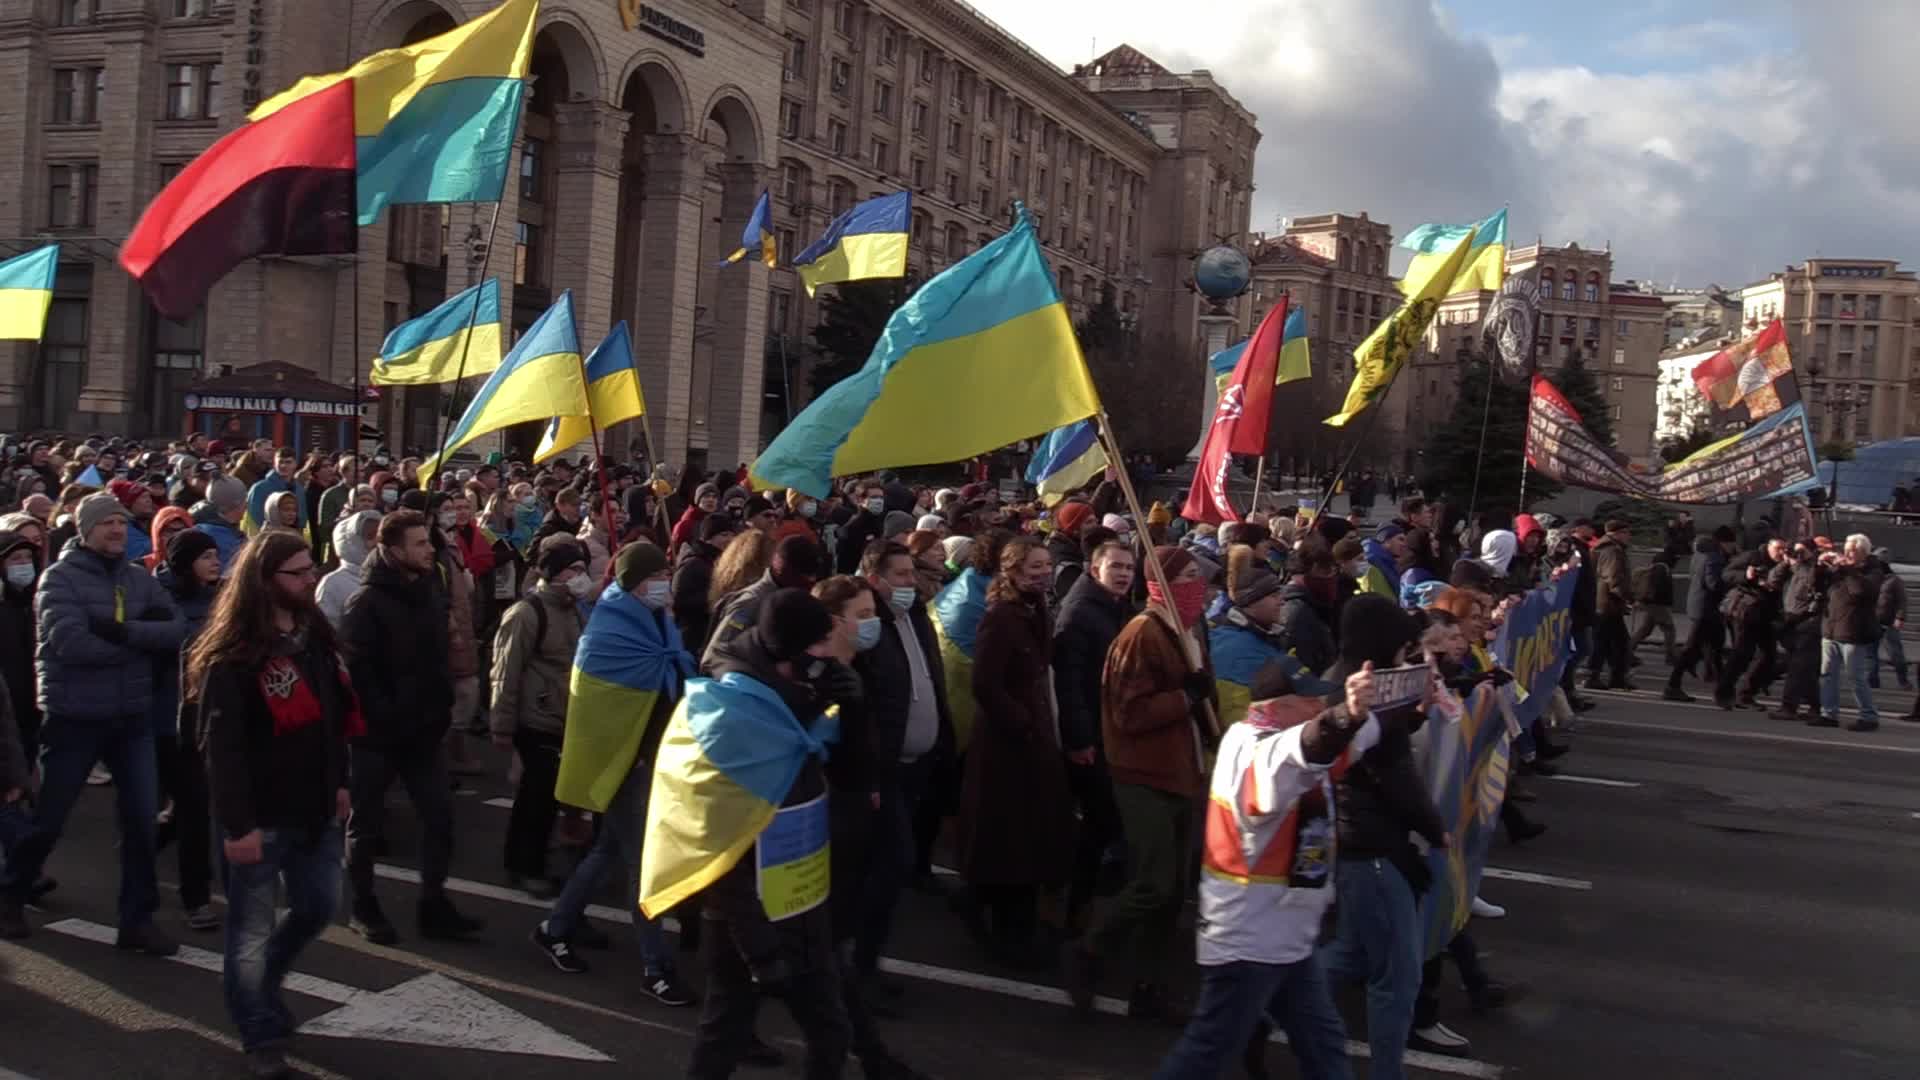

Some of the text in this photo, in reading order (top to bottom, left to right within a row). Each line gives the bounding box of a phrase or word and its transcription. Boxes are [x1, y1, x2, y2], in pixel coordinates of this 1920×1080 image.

[201, 396, 276, 410] AROMA KAVA
[296, 401, 332, 414] AROMA
